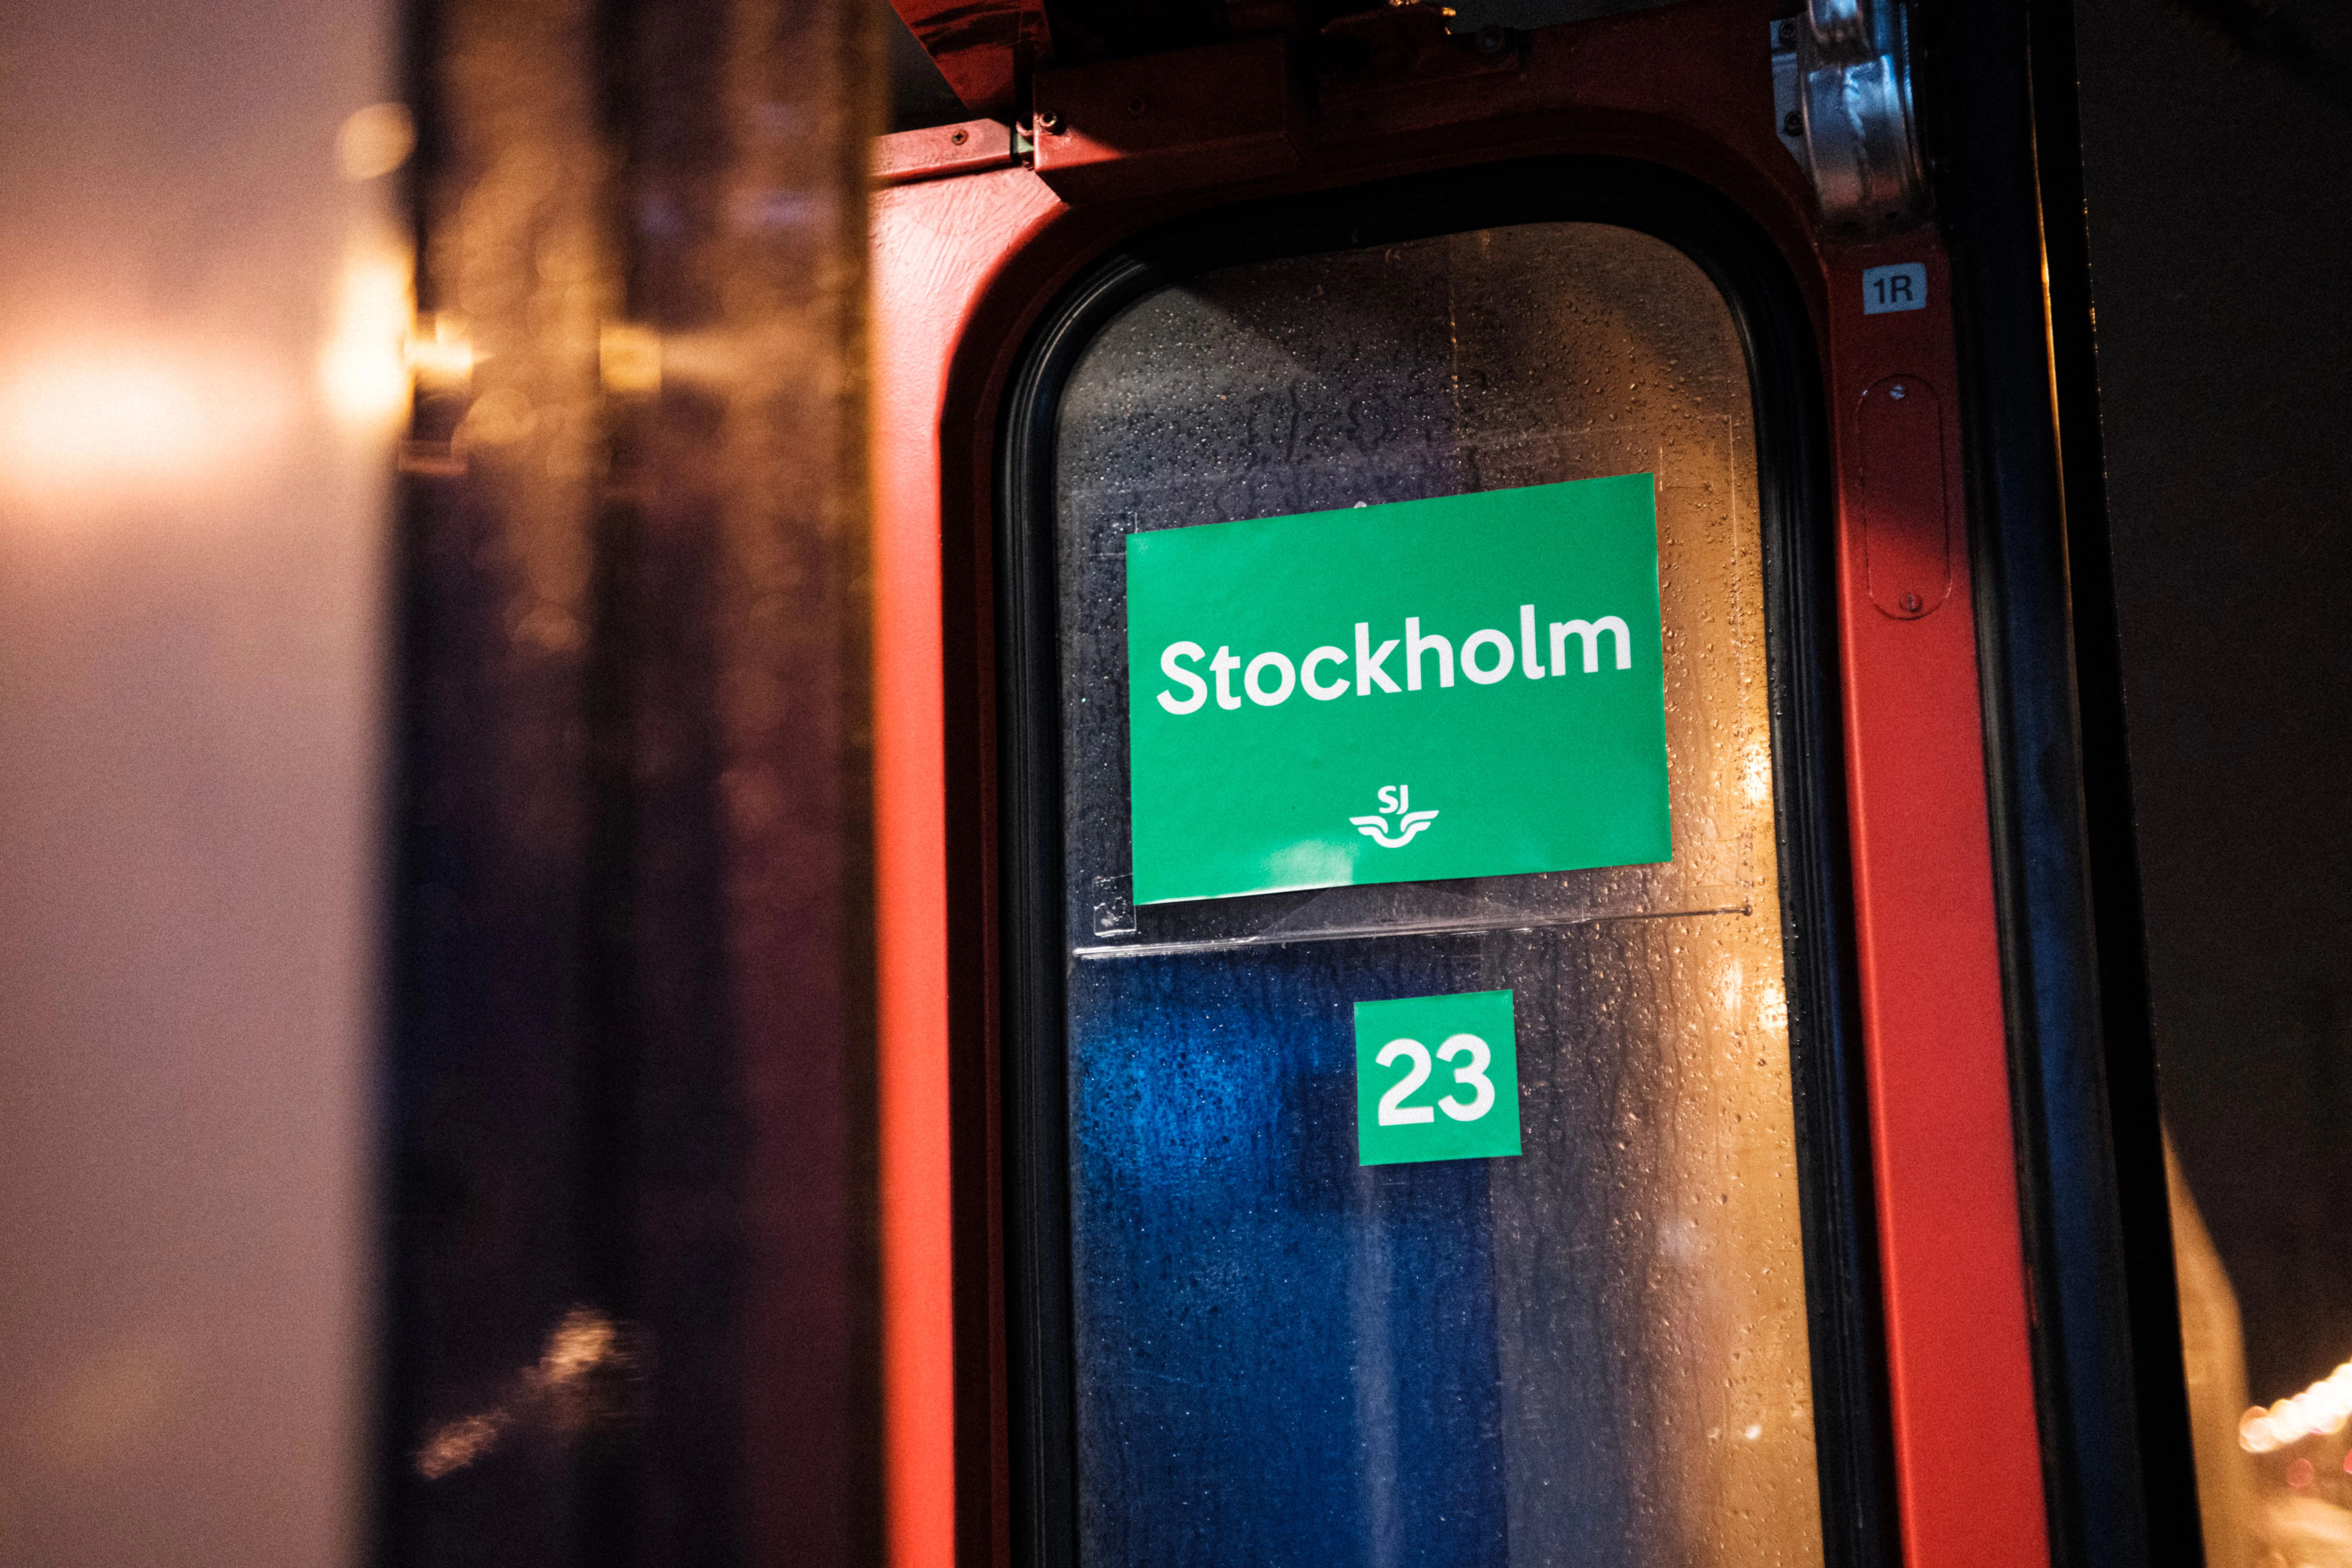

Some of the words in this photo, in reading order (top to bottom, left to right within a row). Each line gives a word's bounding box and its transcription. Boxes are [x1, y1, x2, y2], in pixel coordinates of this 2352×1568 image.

[1873, 275, 1913, 305] 1R
[1156, 604, 1631, 715] Stockholm
[1377, 784, 1409, 815] SJ
[1376, 1033, 1495, 1126] 23
